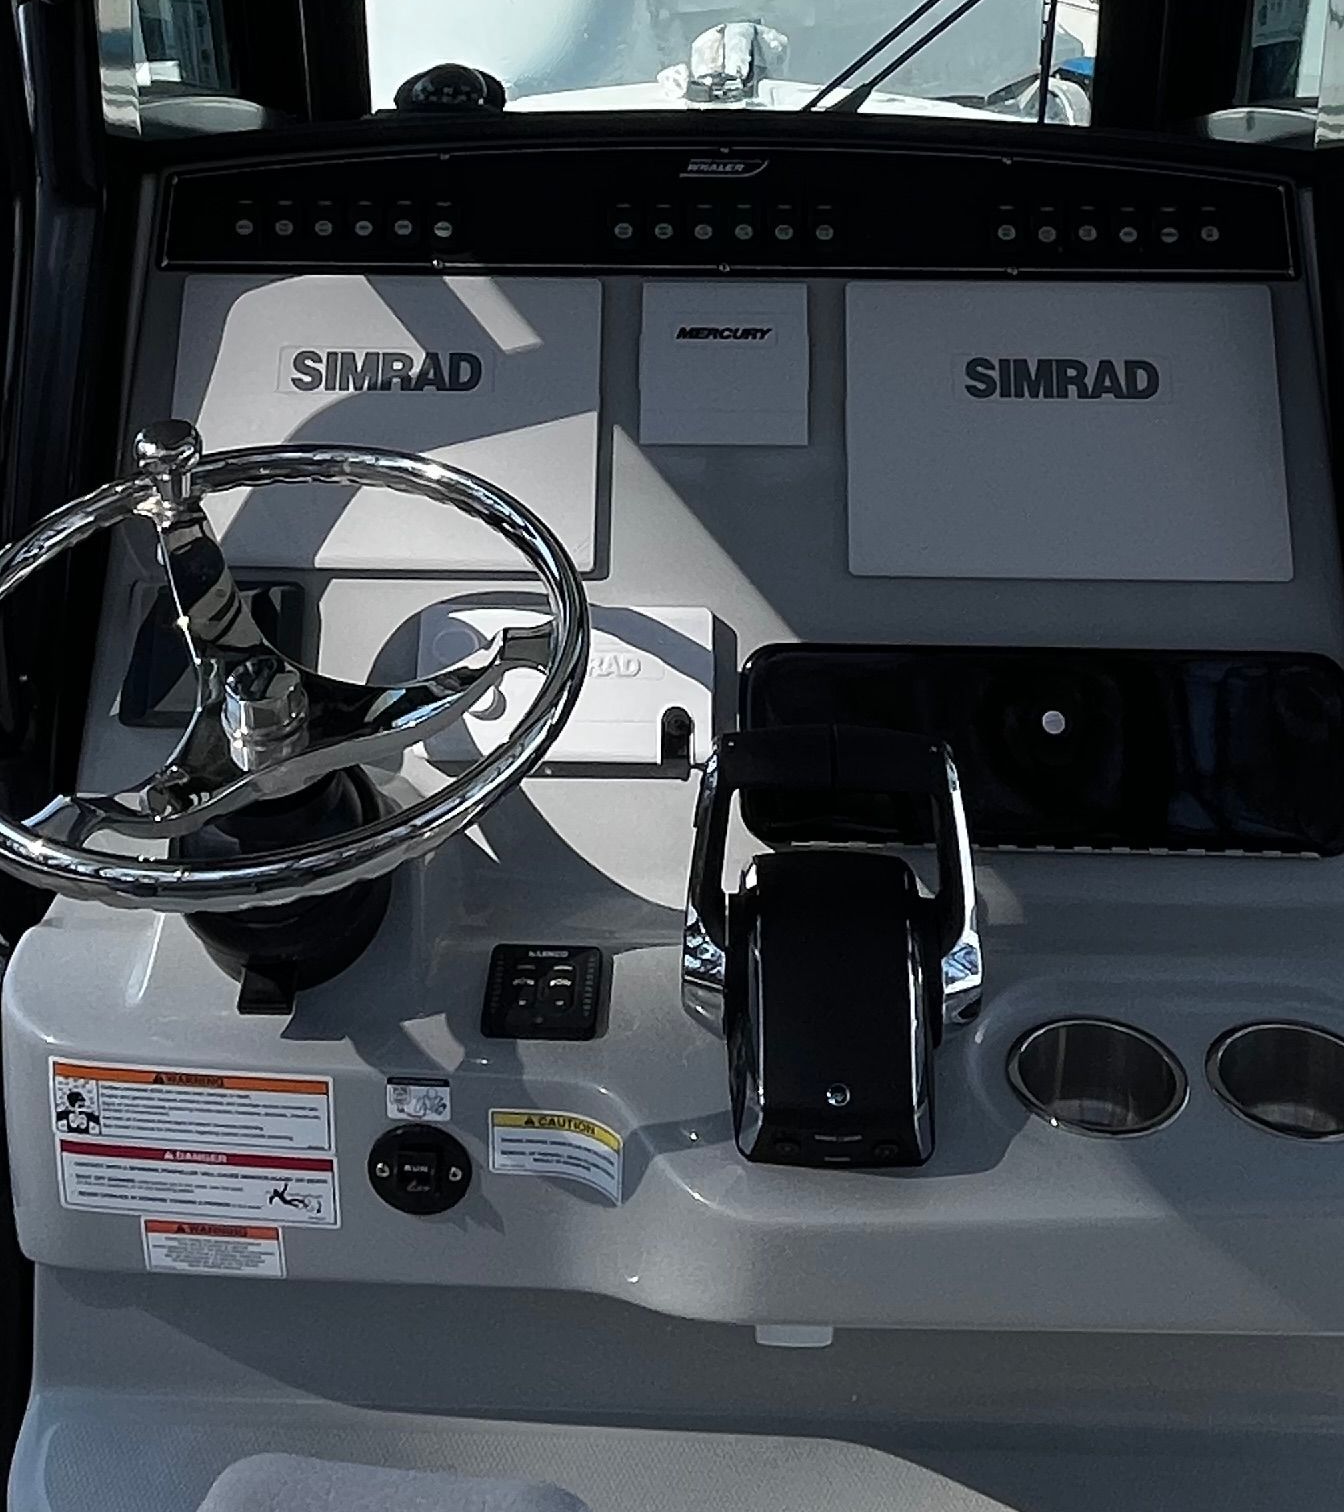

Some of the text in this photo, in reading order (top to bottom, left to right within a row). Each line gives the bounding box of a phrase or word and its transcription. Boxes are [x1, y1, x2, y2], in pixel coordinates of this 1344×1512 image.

[676, 327, 772, 340] MERCURY
[290, 350, 483, 392] SIMRAD
[964, 356, 1160, 400] SIMRAD
[588, 655, 642, 678] RAD
[538, 1115, 596, 1136] CAUTION
[175, 1151, 228, 1164] DANGER
